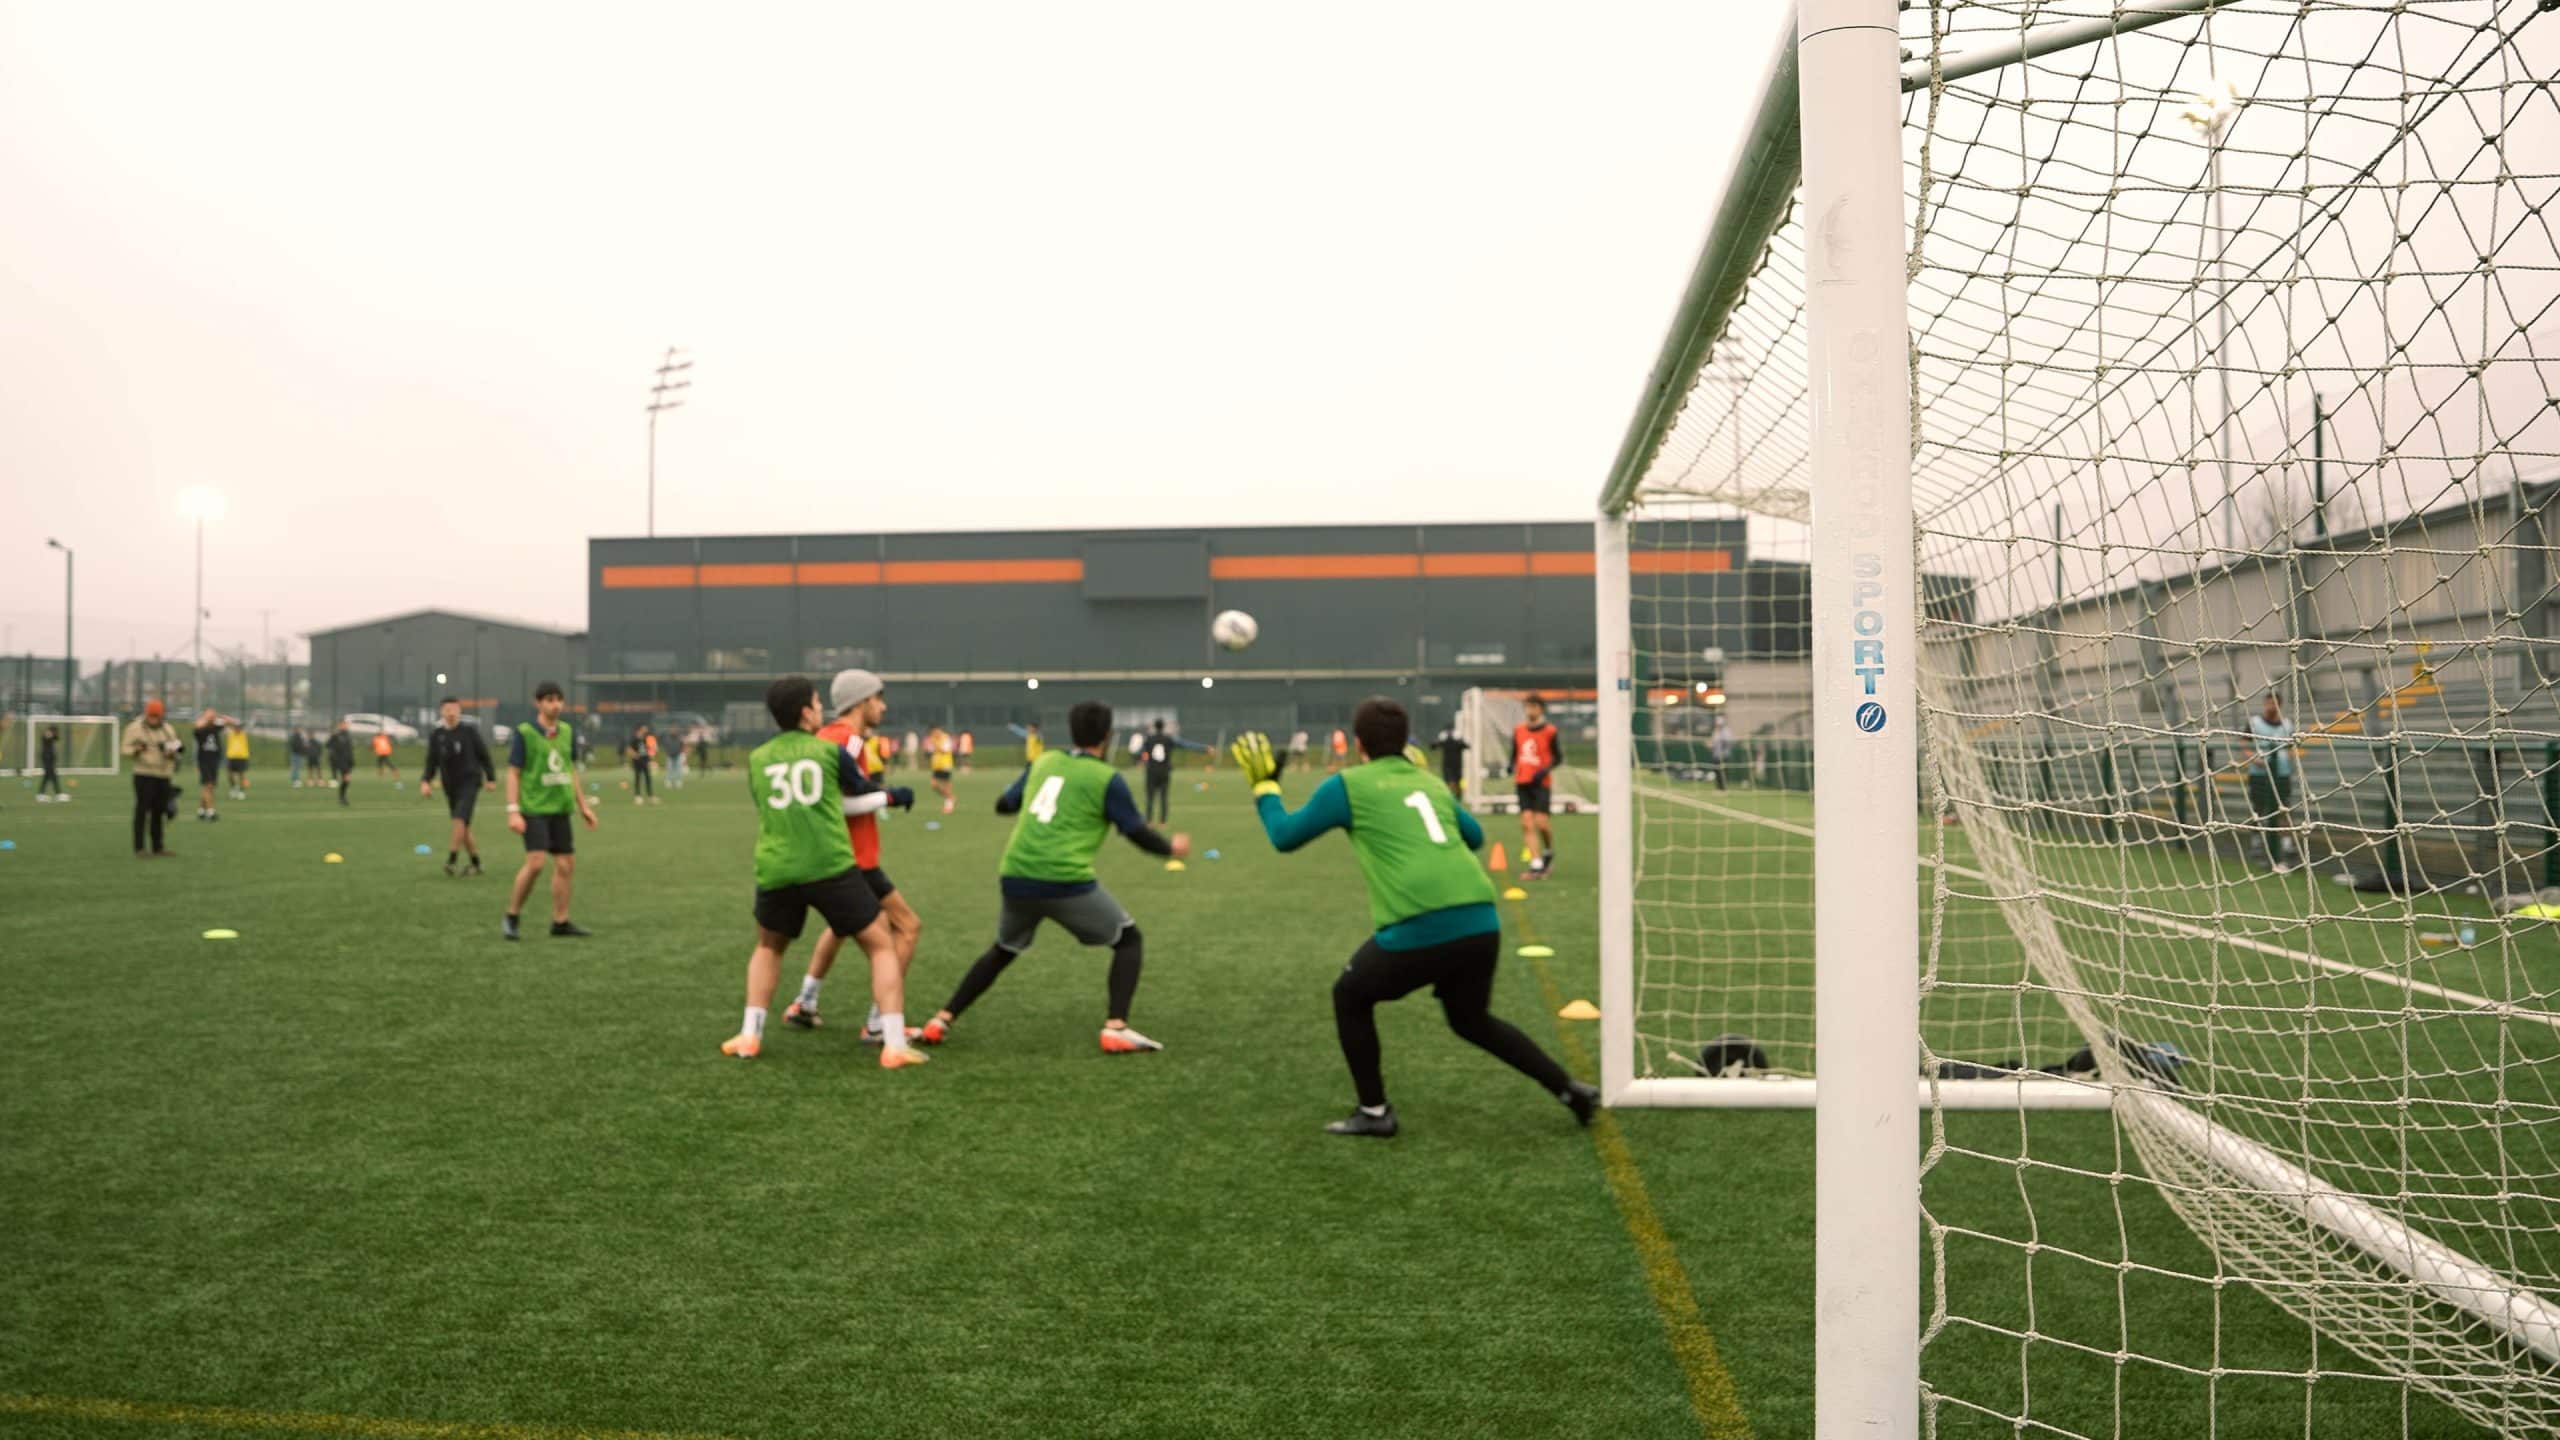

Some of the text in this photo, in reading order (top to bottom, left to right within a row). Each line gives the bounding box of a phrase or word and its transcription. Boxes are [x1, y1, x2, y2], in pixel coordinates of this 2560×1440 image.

[1853, 552, 1885, 694] SPORT
[764, 758, 823, 810] 30
[1029, 775, 1065, 823] 4
[1403, 791, 1447, 844] 1
